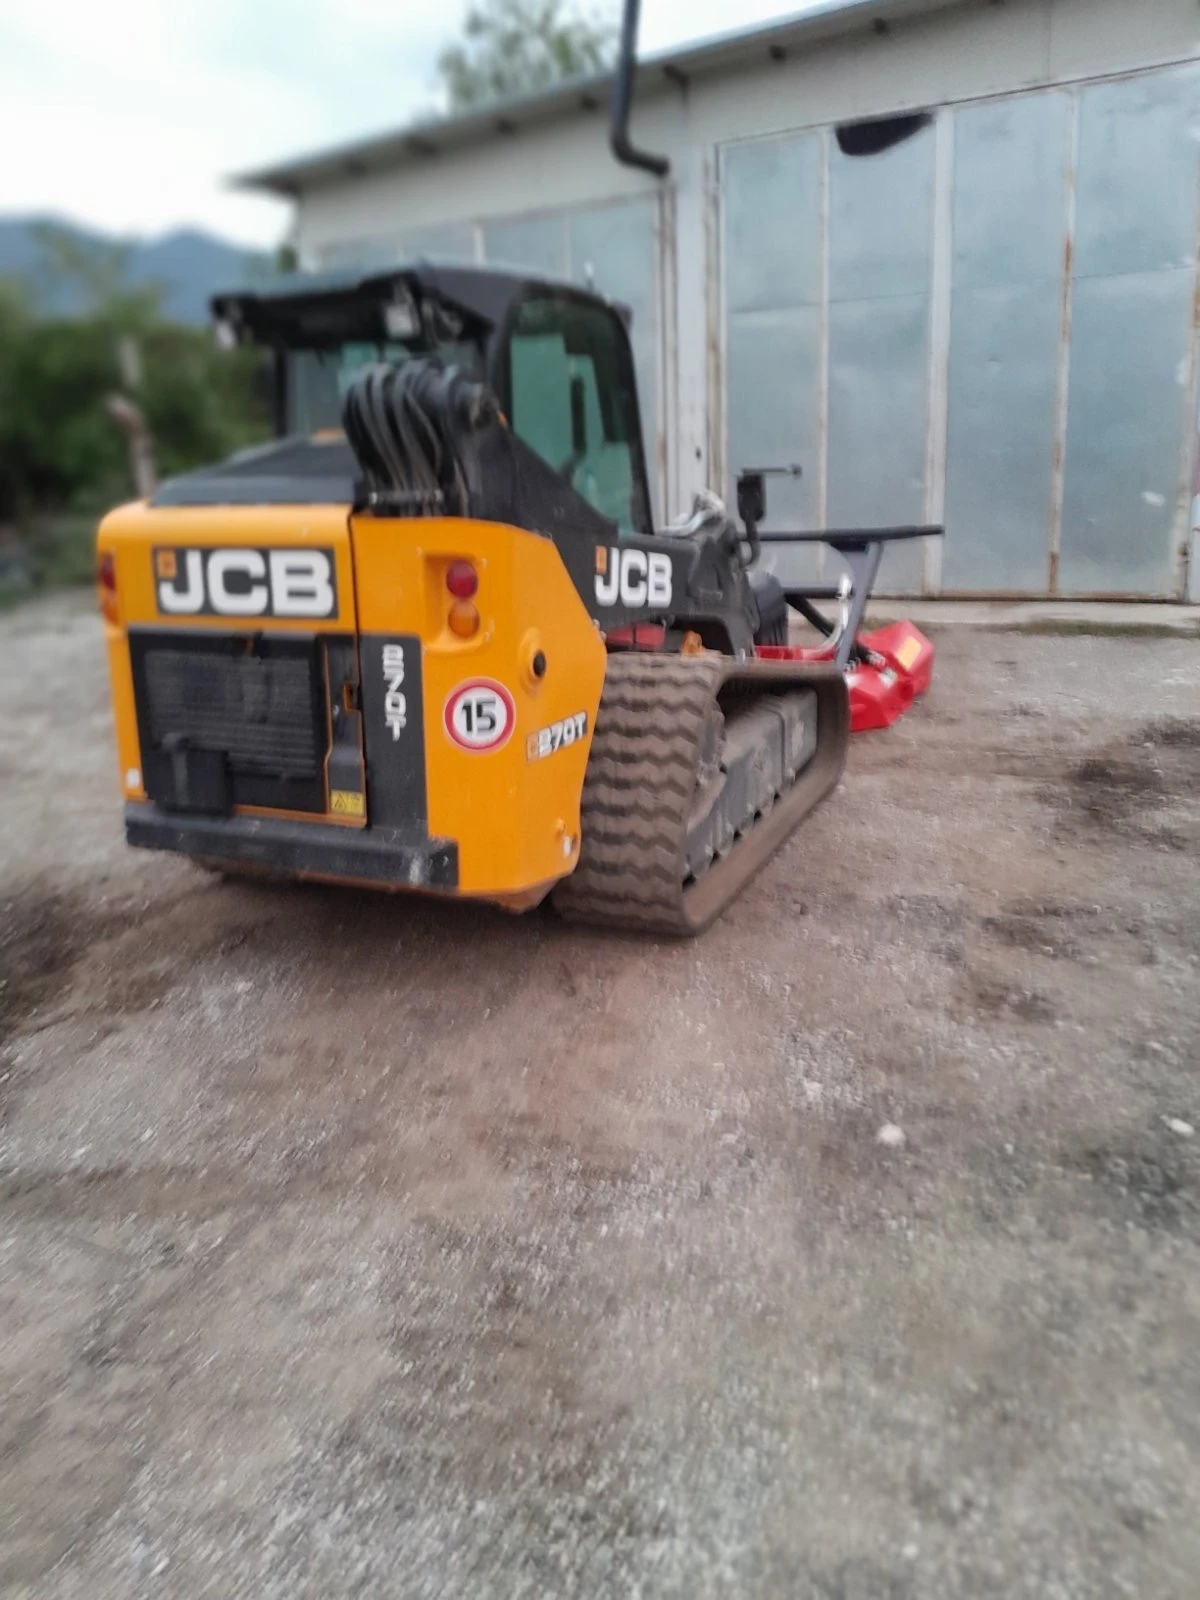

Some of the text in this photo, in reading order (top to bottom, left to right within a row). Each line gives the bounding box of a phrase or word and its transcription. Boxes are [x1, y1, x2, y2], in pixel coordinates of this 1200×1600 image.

[157, 548, 334, 617] JCB
[594, 547, 672, 608] JCB
[460, 697, 496, 734] 15
